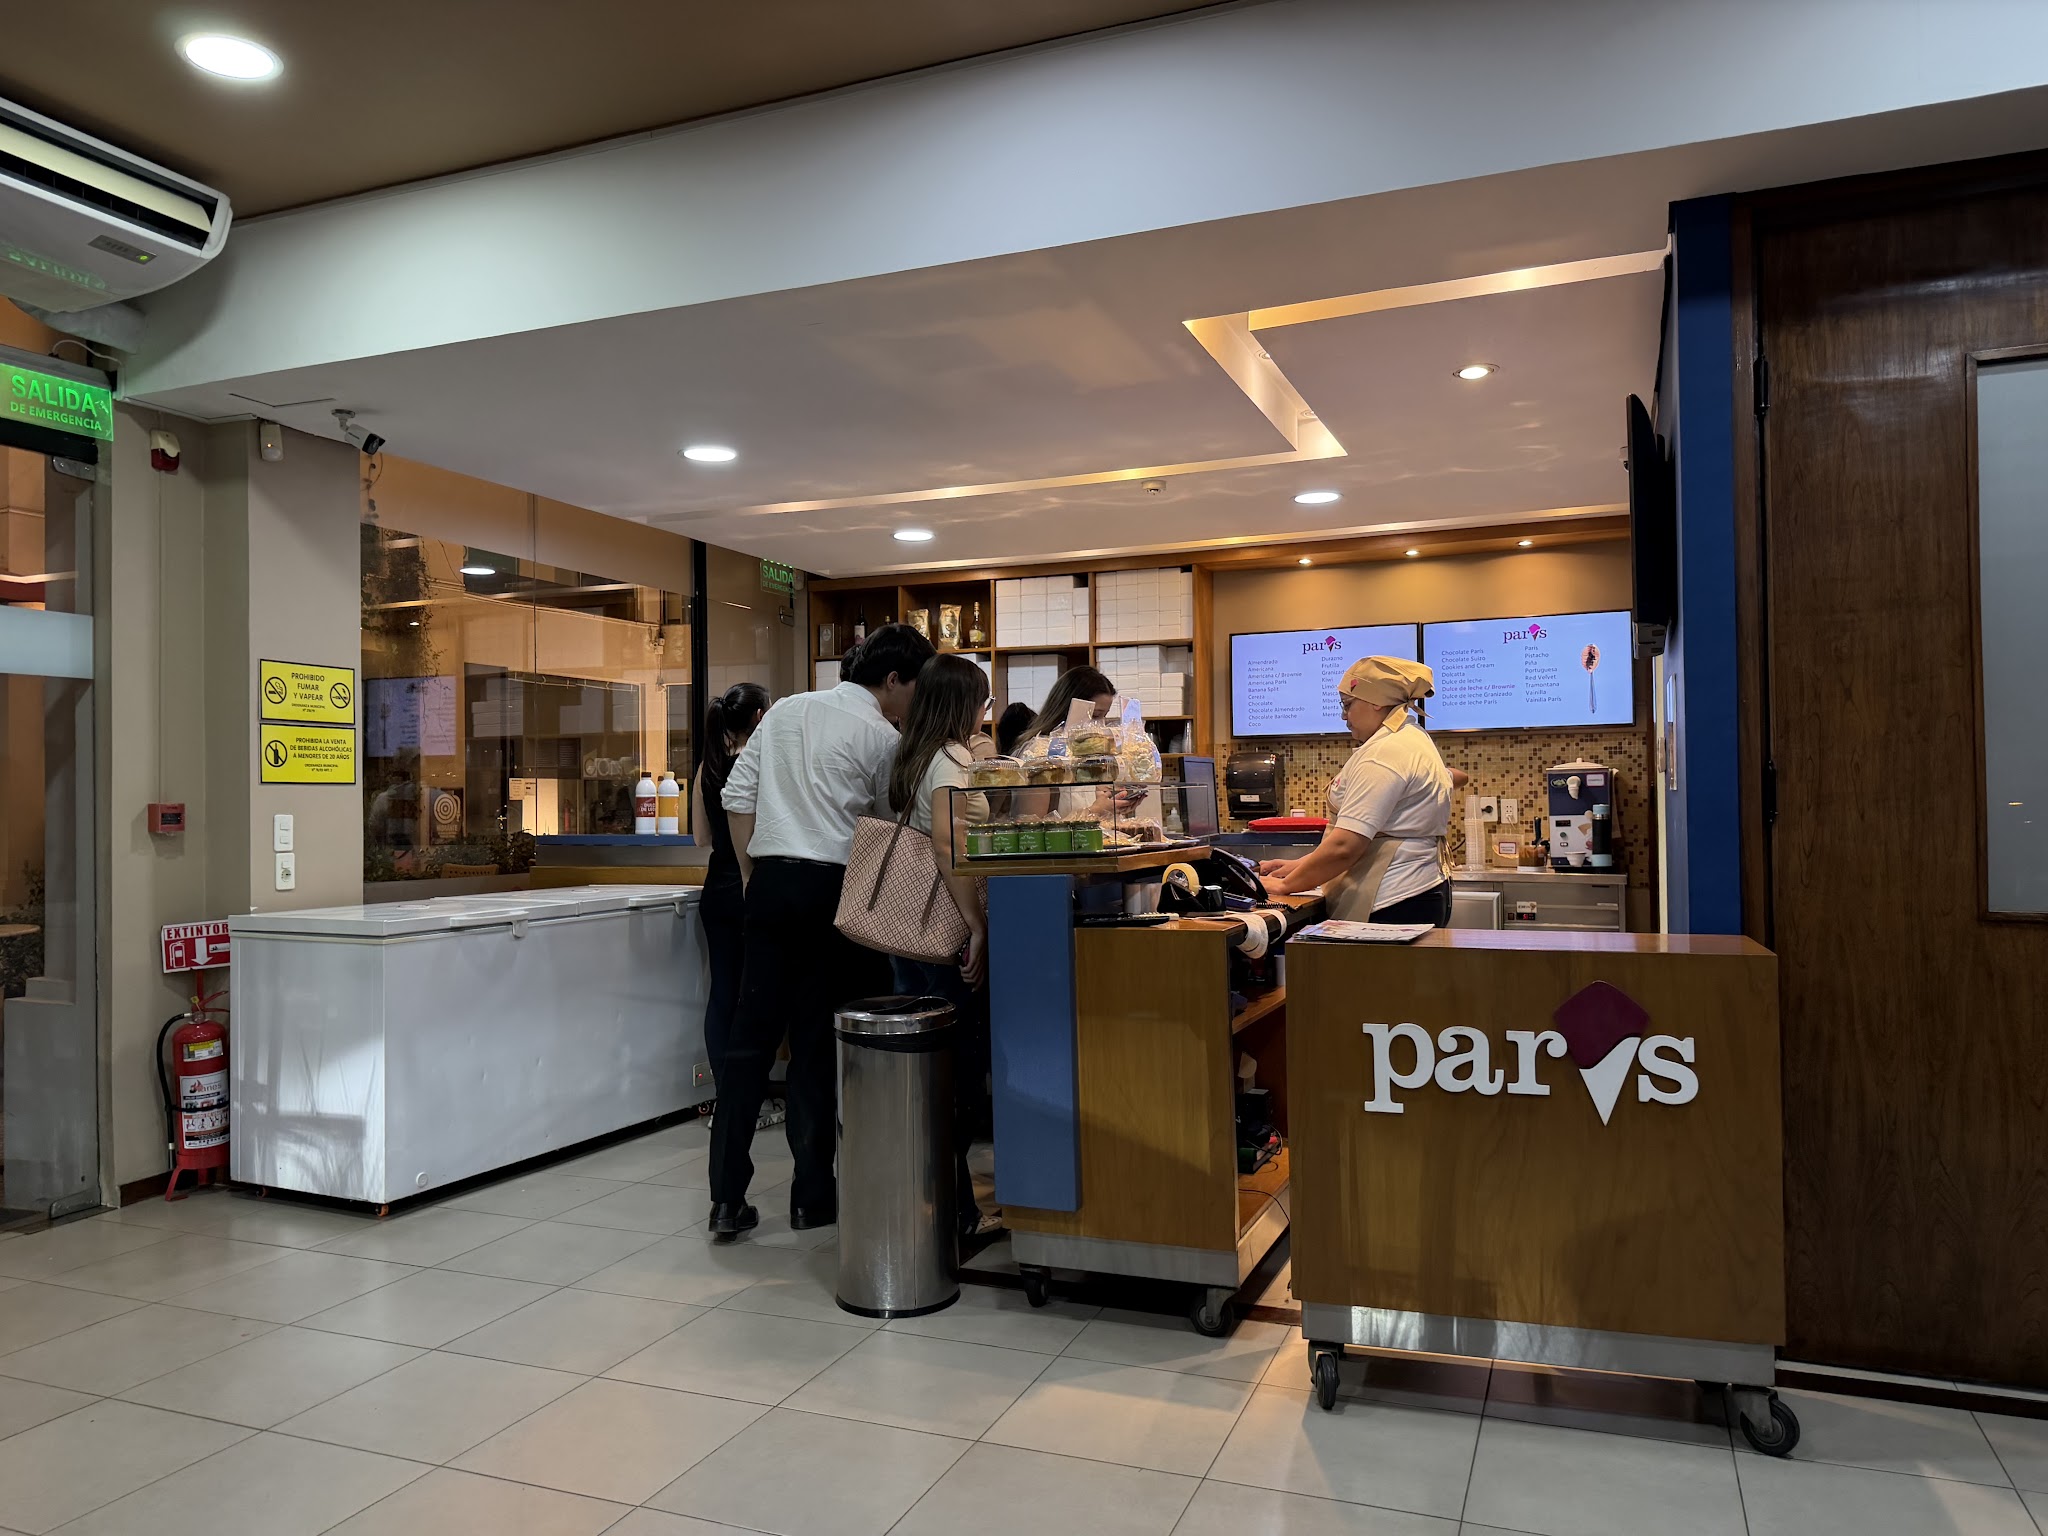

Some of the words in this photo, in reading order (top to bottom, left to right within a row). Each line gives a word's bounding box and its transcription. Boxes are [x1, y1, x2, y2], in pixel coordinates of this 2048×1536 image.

[11, 374, 97, 416] SALIDA
[10, 402, 26, 414] DE
[29, 406, 102, 431] EMERGENCIA
[763, 566, 794, 584] SALIDA
[291, 672, 325, 681] PROHIBIDO
[298, 683, 319, 691] FUMAR
[167, 923, 229, 939] EXTINTOR
